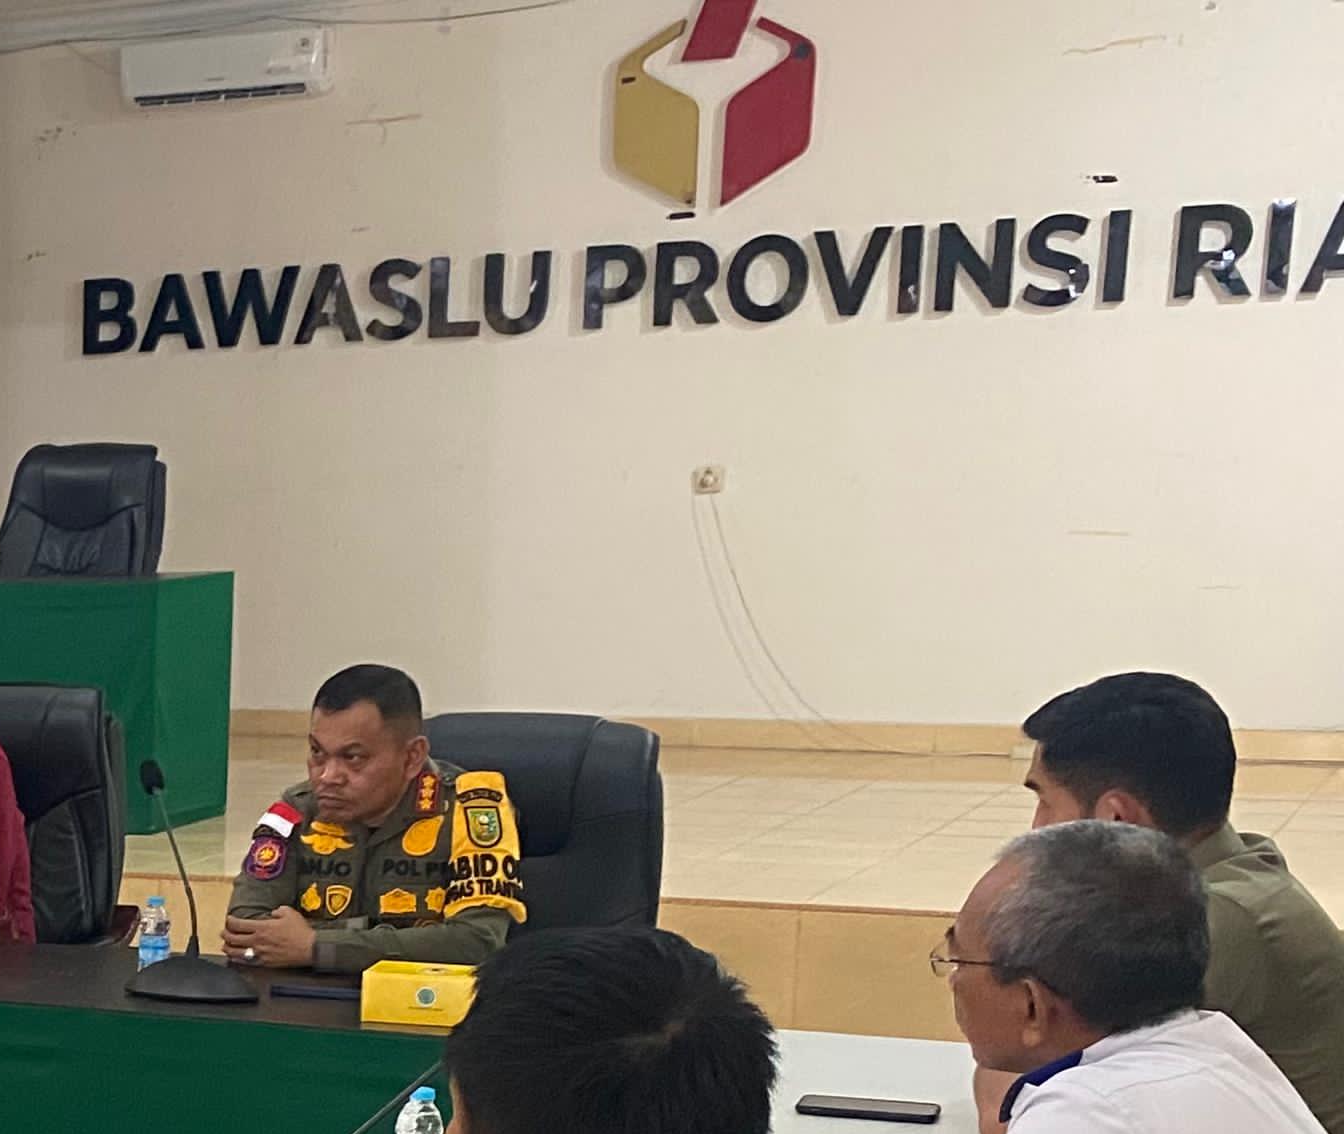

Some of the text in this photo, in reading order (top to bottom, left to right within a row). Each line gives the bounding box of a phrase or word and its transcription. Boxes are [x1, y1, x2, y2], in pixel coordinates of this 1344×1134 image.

[82, 250, 552, 356] BAWASLU
[582, 208, 1133, 331] PROVINSI
[383, 858, 422, 878] POL
